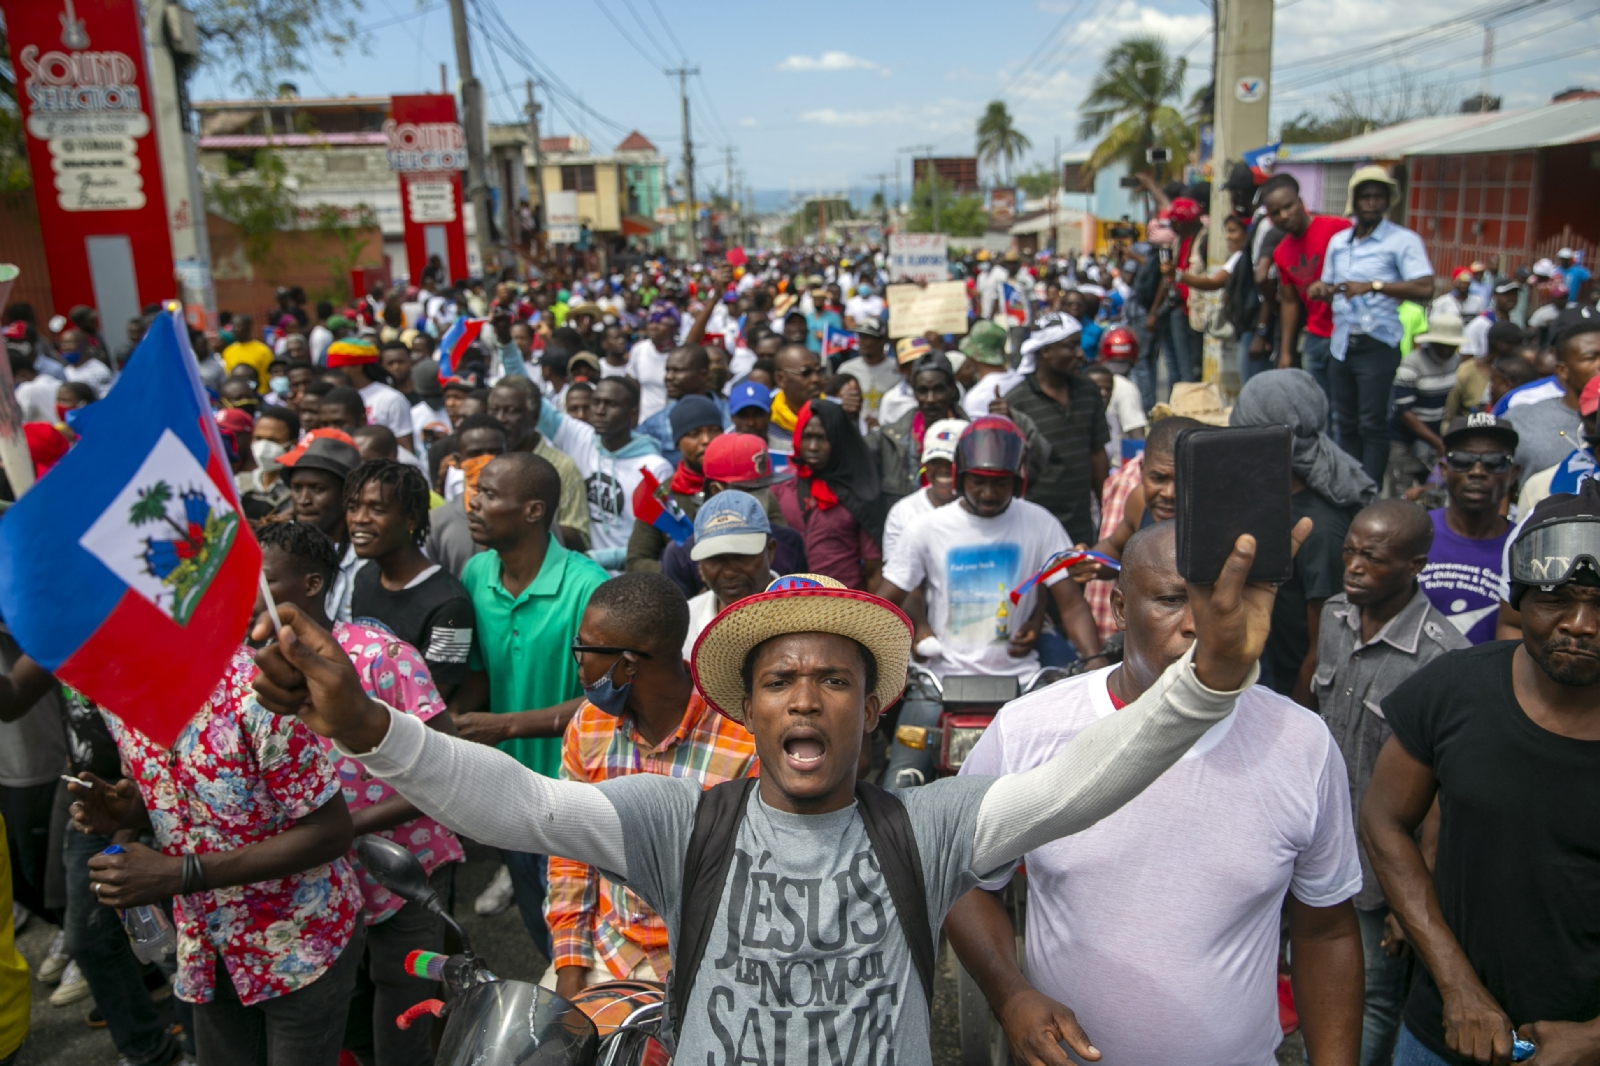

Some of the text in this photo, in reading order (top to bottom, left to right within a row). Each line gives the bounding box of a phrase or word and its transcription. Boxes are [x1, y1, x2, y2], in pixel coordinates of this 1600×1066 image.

[20, 44, 137, 87] SOUND
[382, 119, 465, 152] SOUND
[1425, 581, 1454, 589] Delray
[1433, 571, 1470, 581] Children
[734, 951, 887, 1008] LE NOM QUI
